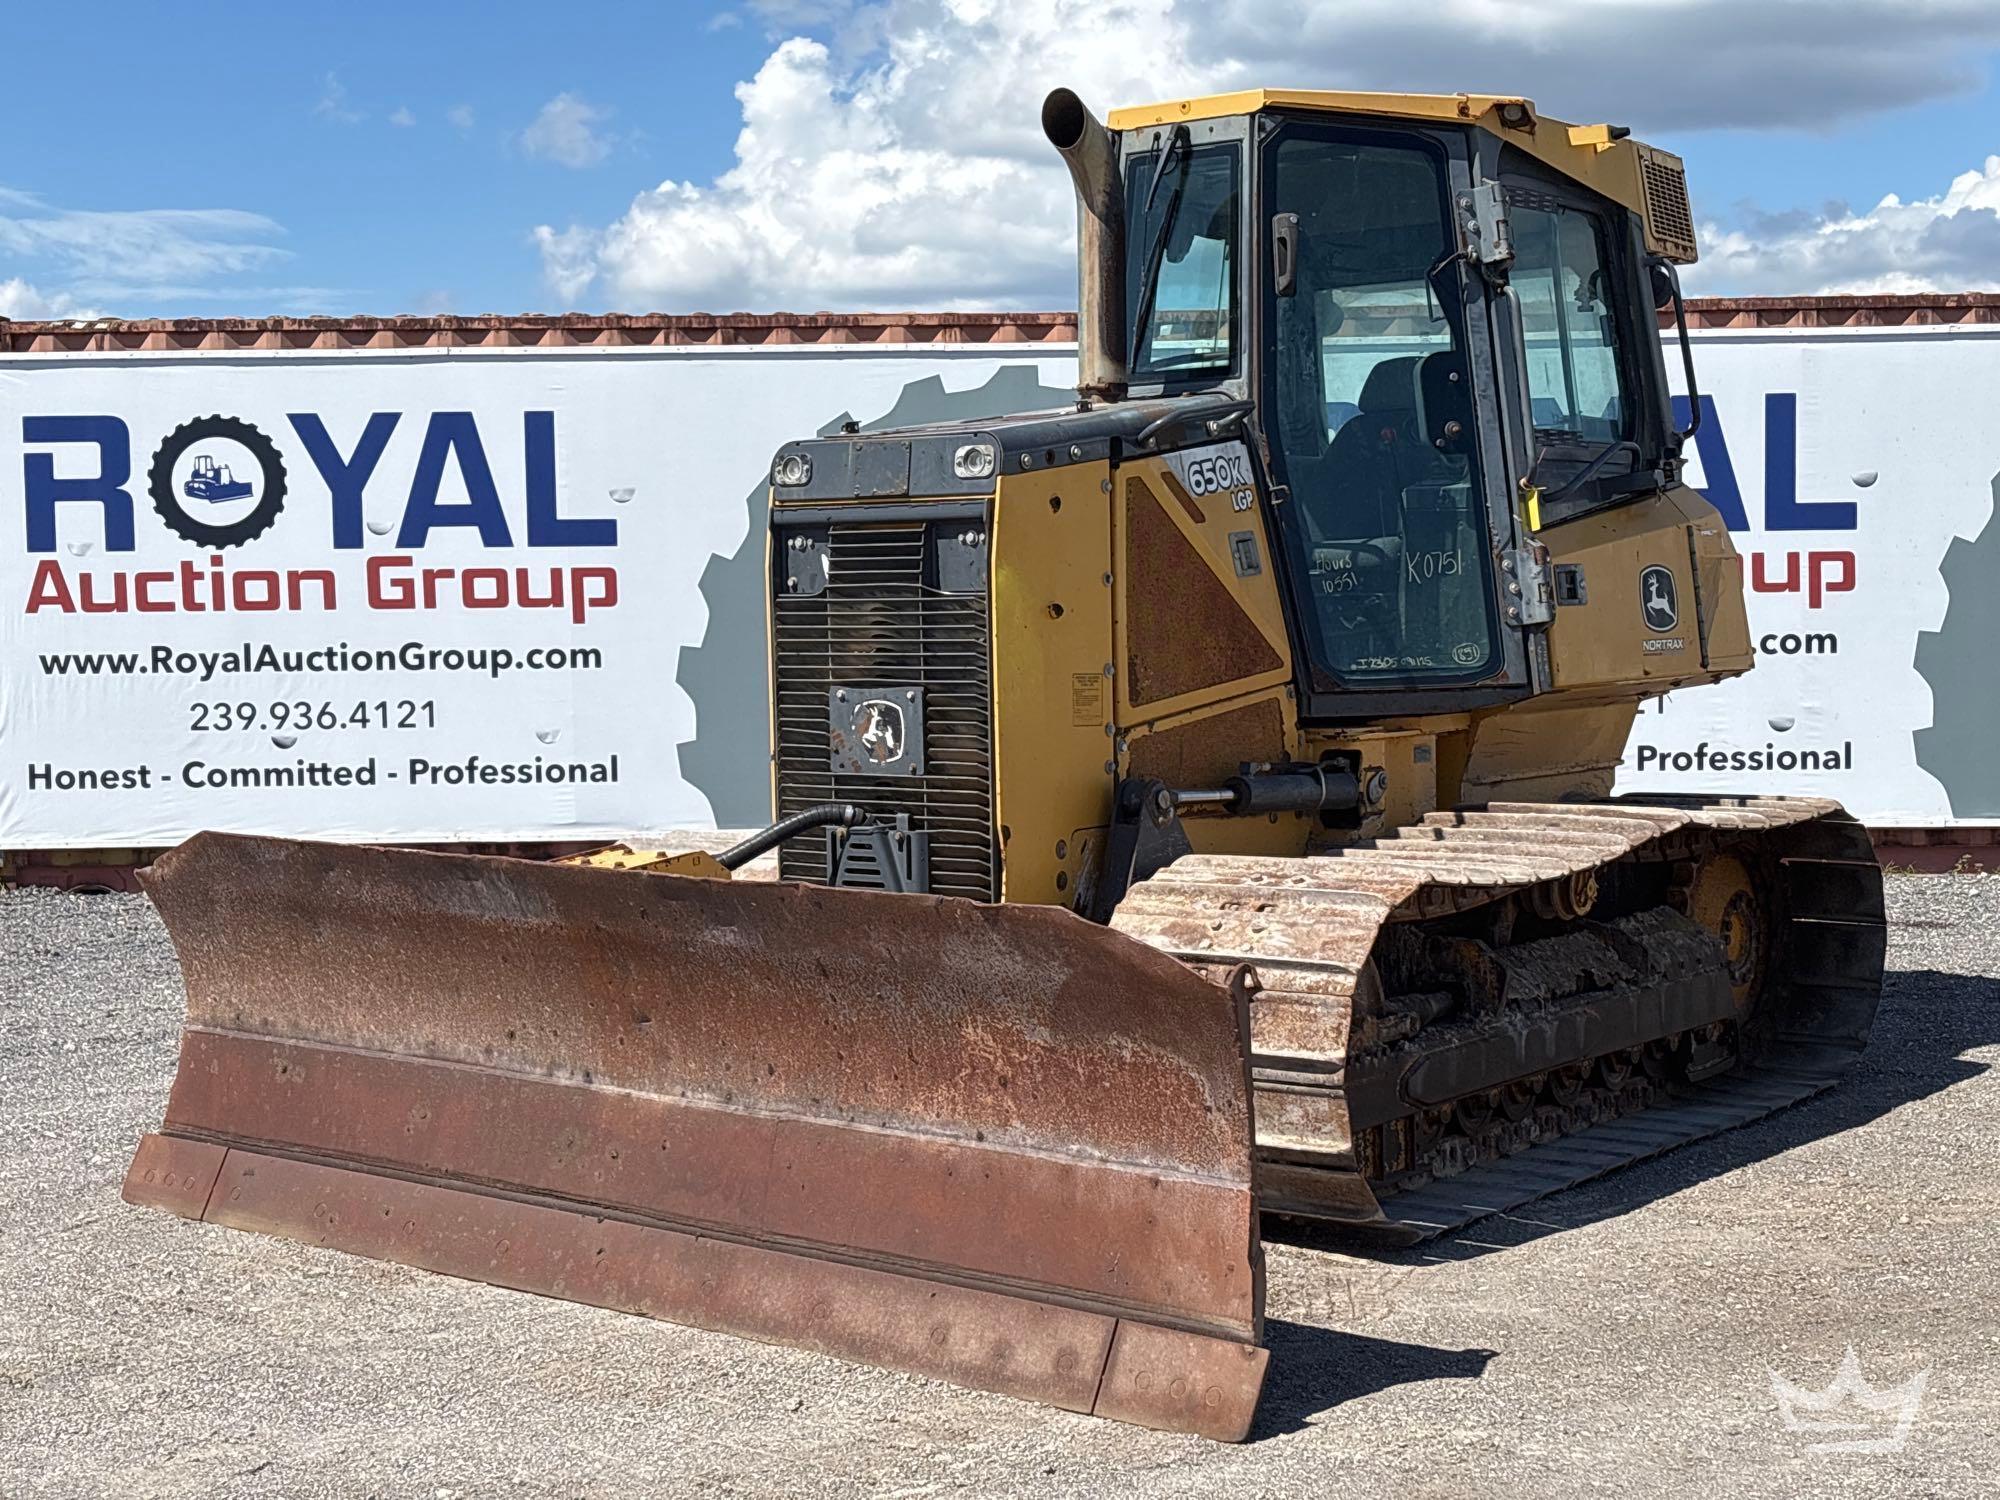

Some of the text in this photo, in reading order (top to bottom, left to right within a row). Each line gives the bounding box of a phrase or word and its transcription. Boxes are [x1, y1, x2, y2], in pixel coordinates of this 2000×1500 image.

[22, 410, 618, 552] ROYAL
[1188, 455, 1247, 496] 650K
[1231, 488, 1254, 513] LGP
[1315, 550, 1353, 574] Hours
[26, 554, 618, 624] Auction Group
[38, 641, 602, 681] www.RoyalAuctionGroup.com
[1642, 639, 1685, 651] NORTRAX
[189, 699, 436, 731] 239.936.4121
[28, 763, 151, 789] Honest
[182, 759, 376, 788] Committed
[409, 754, 618, 785] Professional
[1637, 741, 1852, 772] Professional
